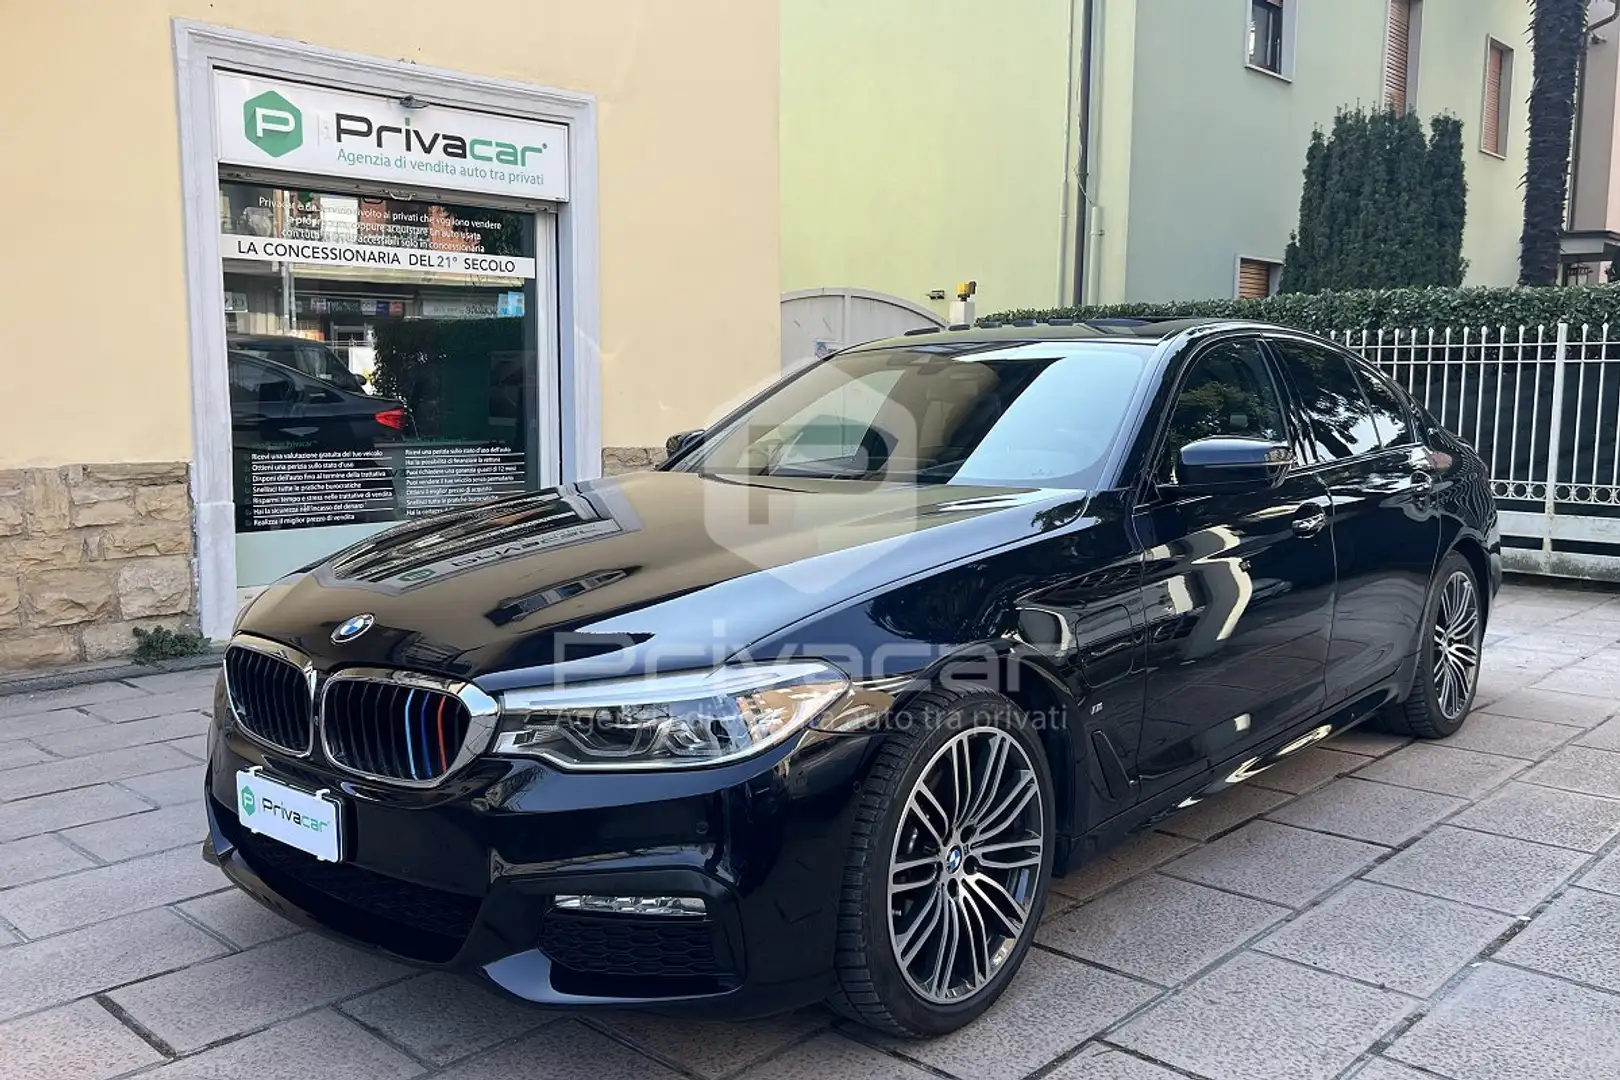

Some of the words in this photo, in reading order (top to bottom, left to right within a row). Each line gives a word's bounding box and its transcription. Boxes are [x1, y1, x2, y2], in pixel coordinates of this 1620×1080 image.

[335, 112, 543, 167] Privacar
[338, 148, 391, 167] Agenzia
[395, 155, 407, 169] di
[410, 157, 456, 175] vendita
[460, 165, 487, 179] auto
[489, 168, 505, 181] tra
[508, 171, 544, 185] privati
[392, 210, 419, 223] privati
[420, 212, 435, 225] che
[437, 214, 470, 227] vogliono
[471, 219, 503, 230] vendere
[238, 240, 258, 255] LA
[263, 242, 400, 265] CONCESSIONARIA
[409, 253, 435, 268] DEL
[437, 255, 458, 268] 21°
[464, 257, 516, 273] SECOLO
[358, 233, 399, 246] accessibili
[401, 237, 418, 248] solo
[262, 797, 328, 832] Privacar
